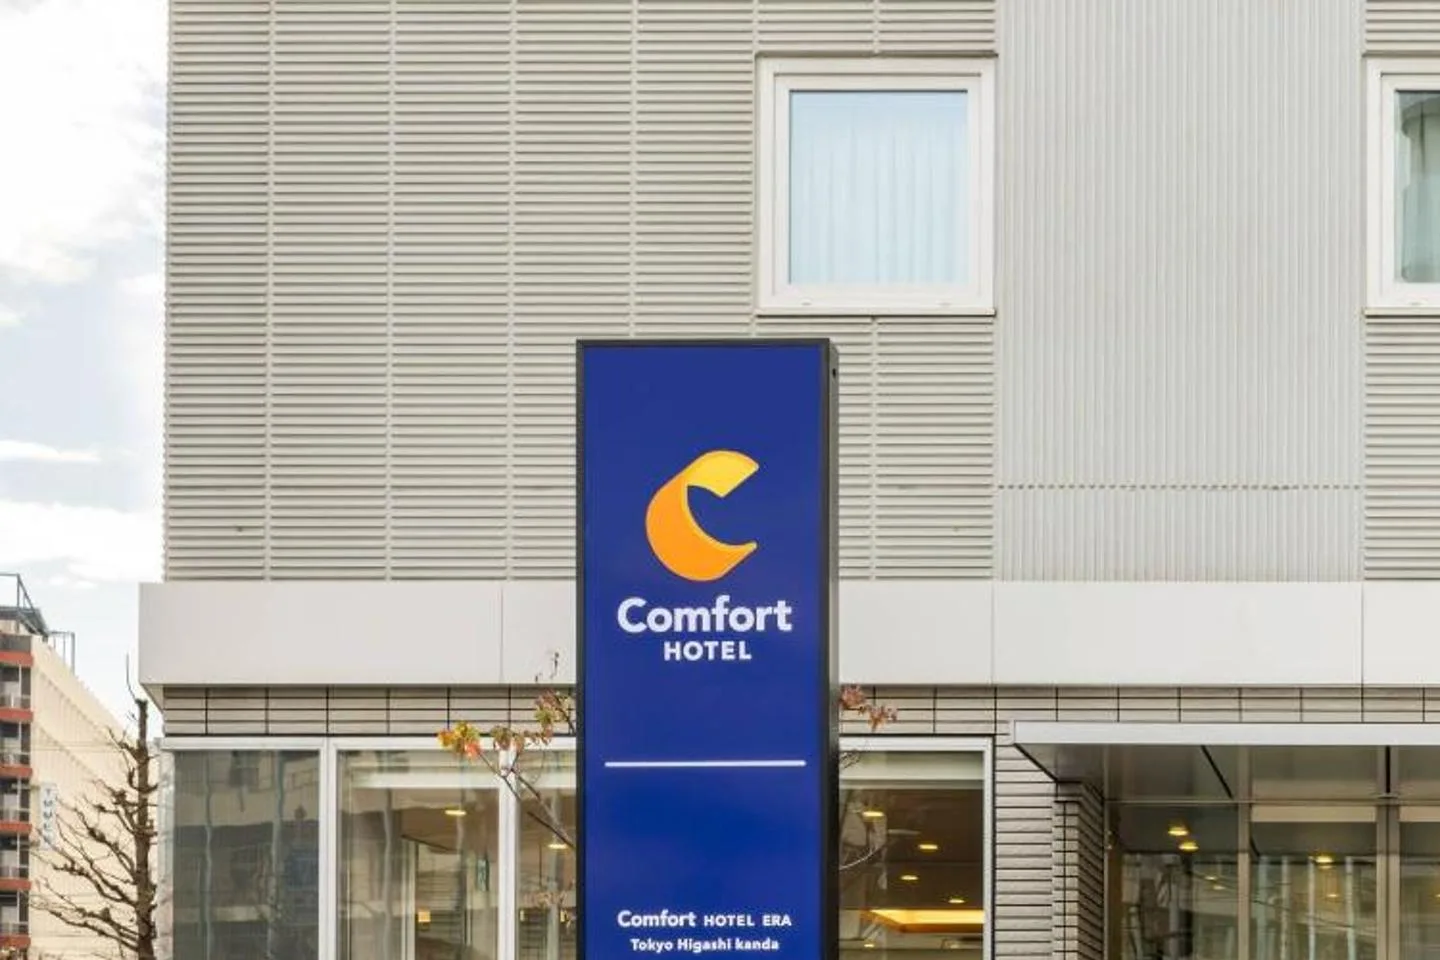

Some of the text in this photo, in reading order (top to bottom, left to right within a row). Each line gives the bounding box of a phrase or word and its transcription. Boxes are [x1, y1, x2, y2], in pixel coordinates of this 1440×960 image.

[617, 595, 793, 633] Comfort
[663, 640, 752, 662] HOTEL
[617, 909, 792, 928] Comfort HOTEL ERA
[631, 938, 674, 954] Tokyo
[677, 938, 731, 954] Higashi
